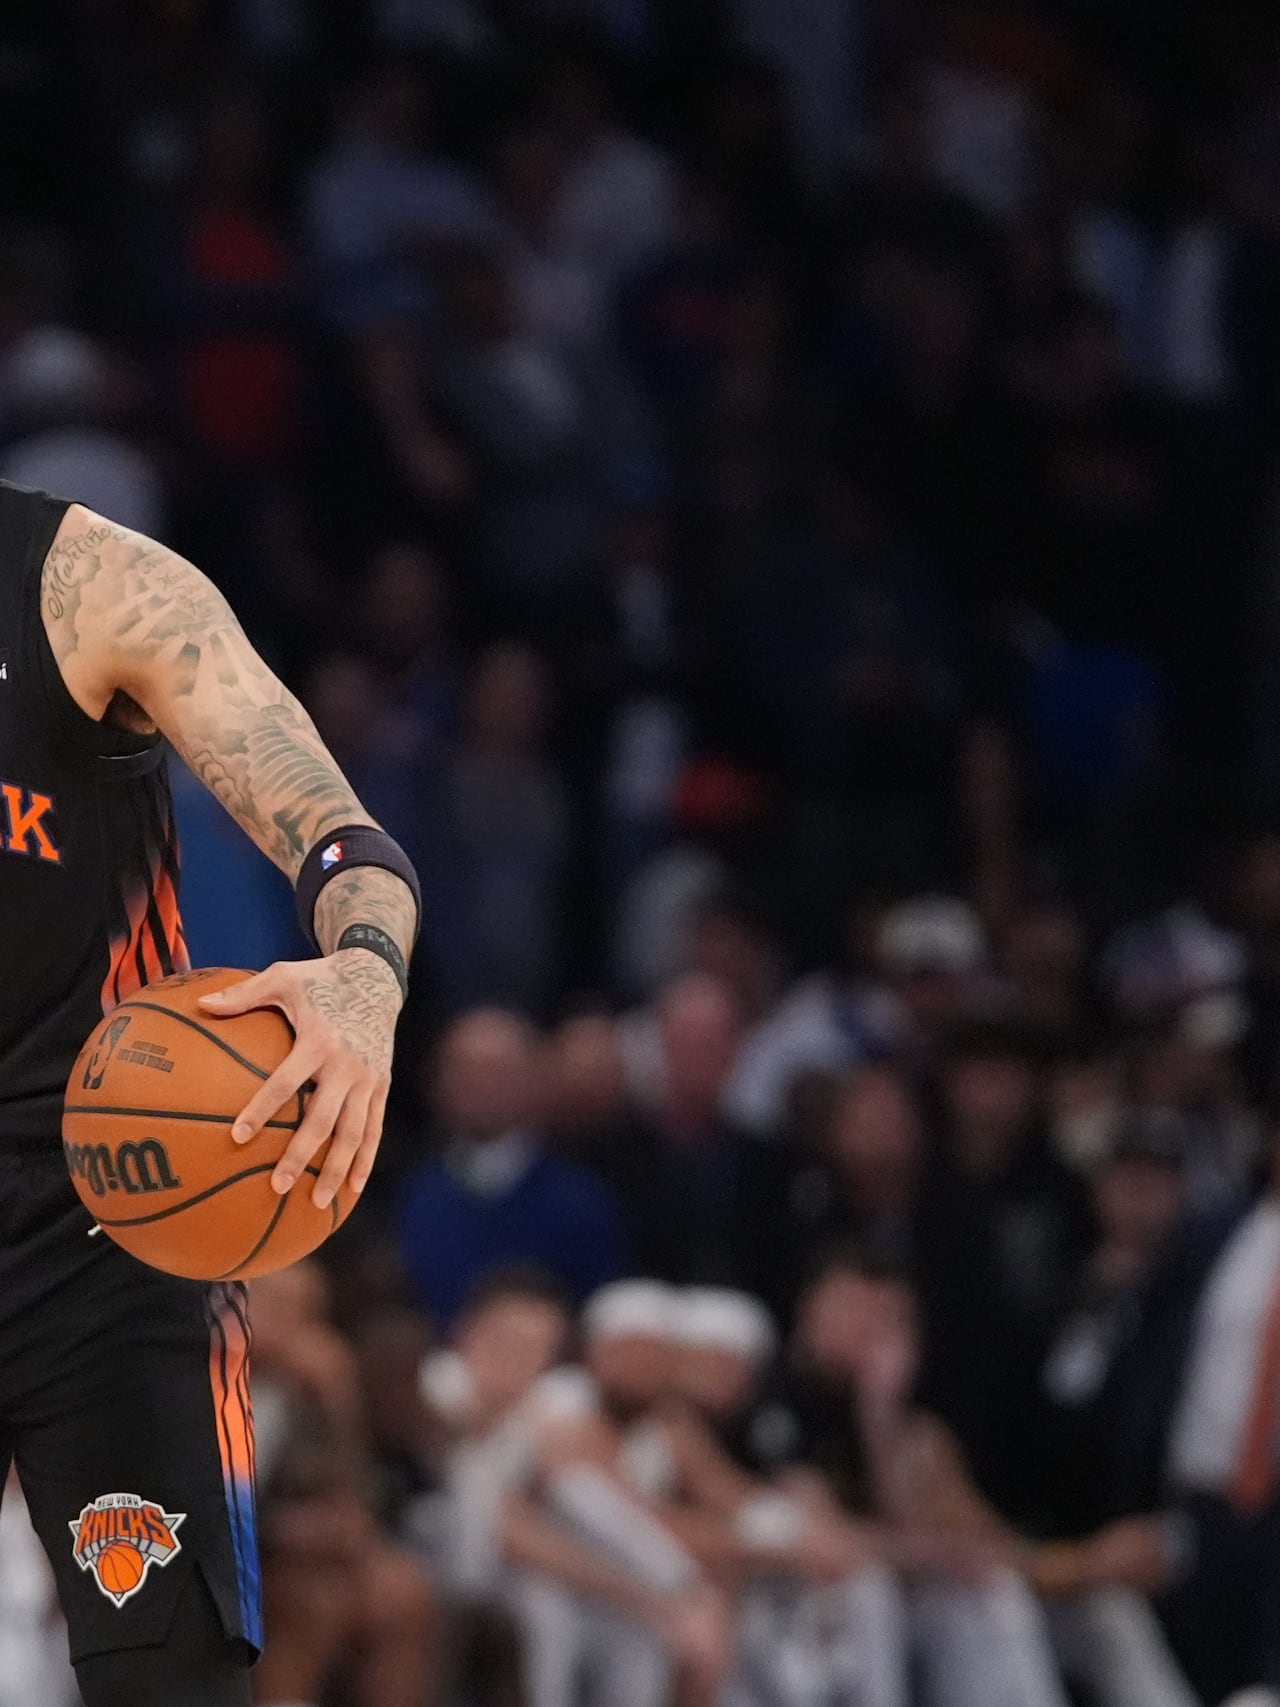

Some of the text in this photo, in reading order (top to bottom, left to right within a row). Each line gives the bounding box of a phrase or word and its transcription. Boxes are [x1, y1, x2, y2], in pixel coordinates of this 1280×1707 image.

[97, 1495, 140, 1508] NEW YORK
[76, 1505, 177, 1556] KNICKS
